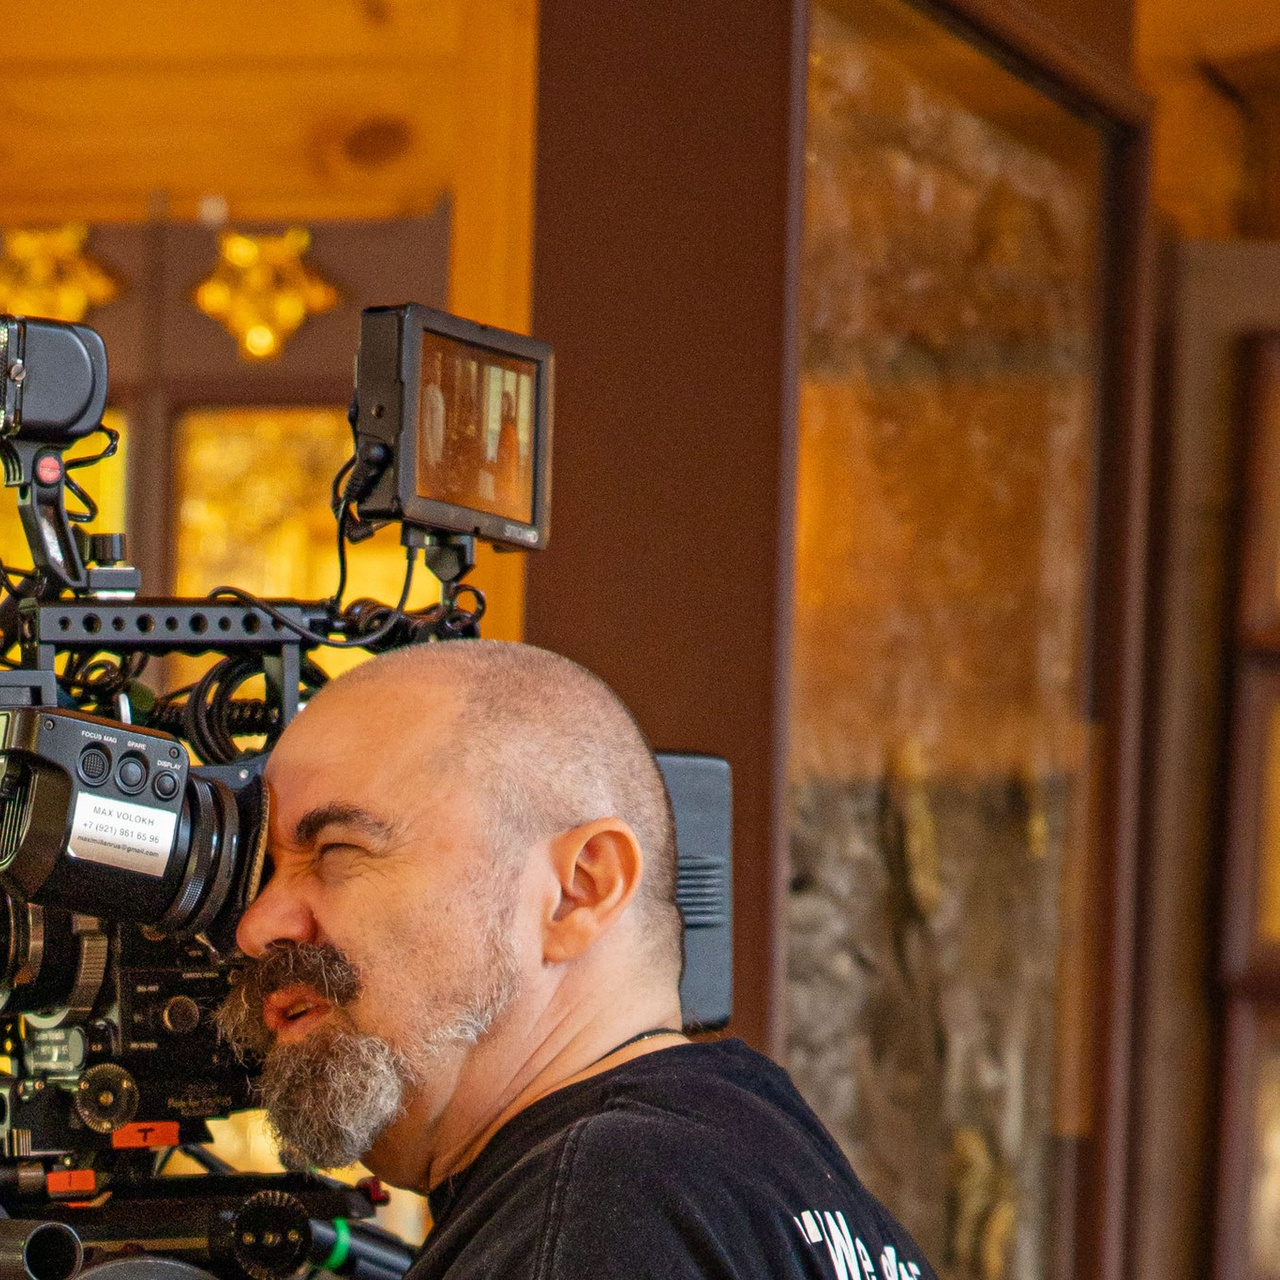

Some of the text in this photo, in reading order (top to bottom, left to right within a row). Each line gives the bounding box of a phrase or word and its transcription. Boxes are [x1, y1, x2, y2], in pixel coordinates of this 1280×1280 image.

[81, 730, 117, 744] FOCUS MAG
[127, 740, 147, 750] SPARE
[157, 760, 182, 770] DISPLAY
[93, 805, 155, 826] MAX VOLOKH
[83, 821, 159, 843] +7 (921) 961 65 96
[137, 1127, 155, 1143] T
